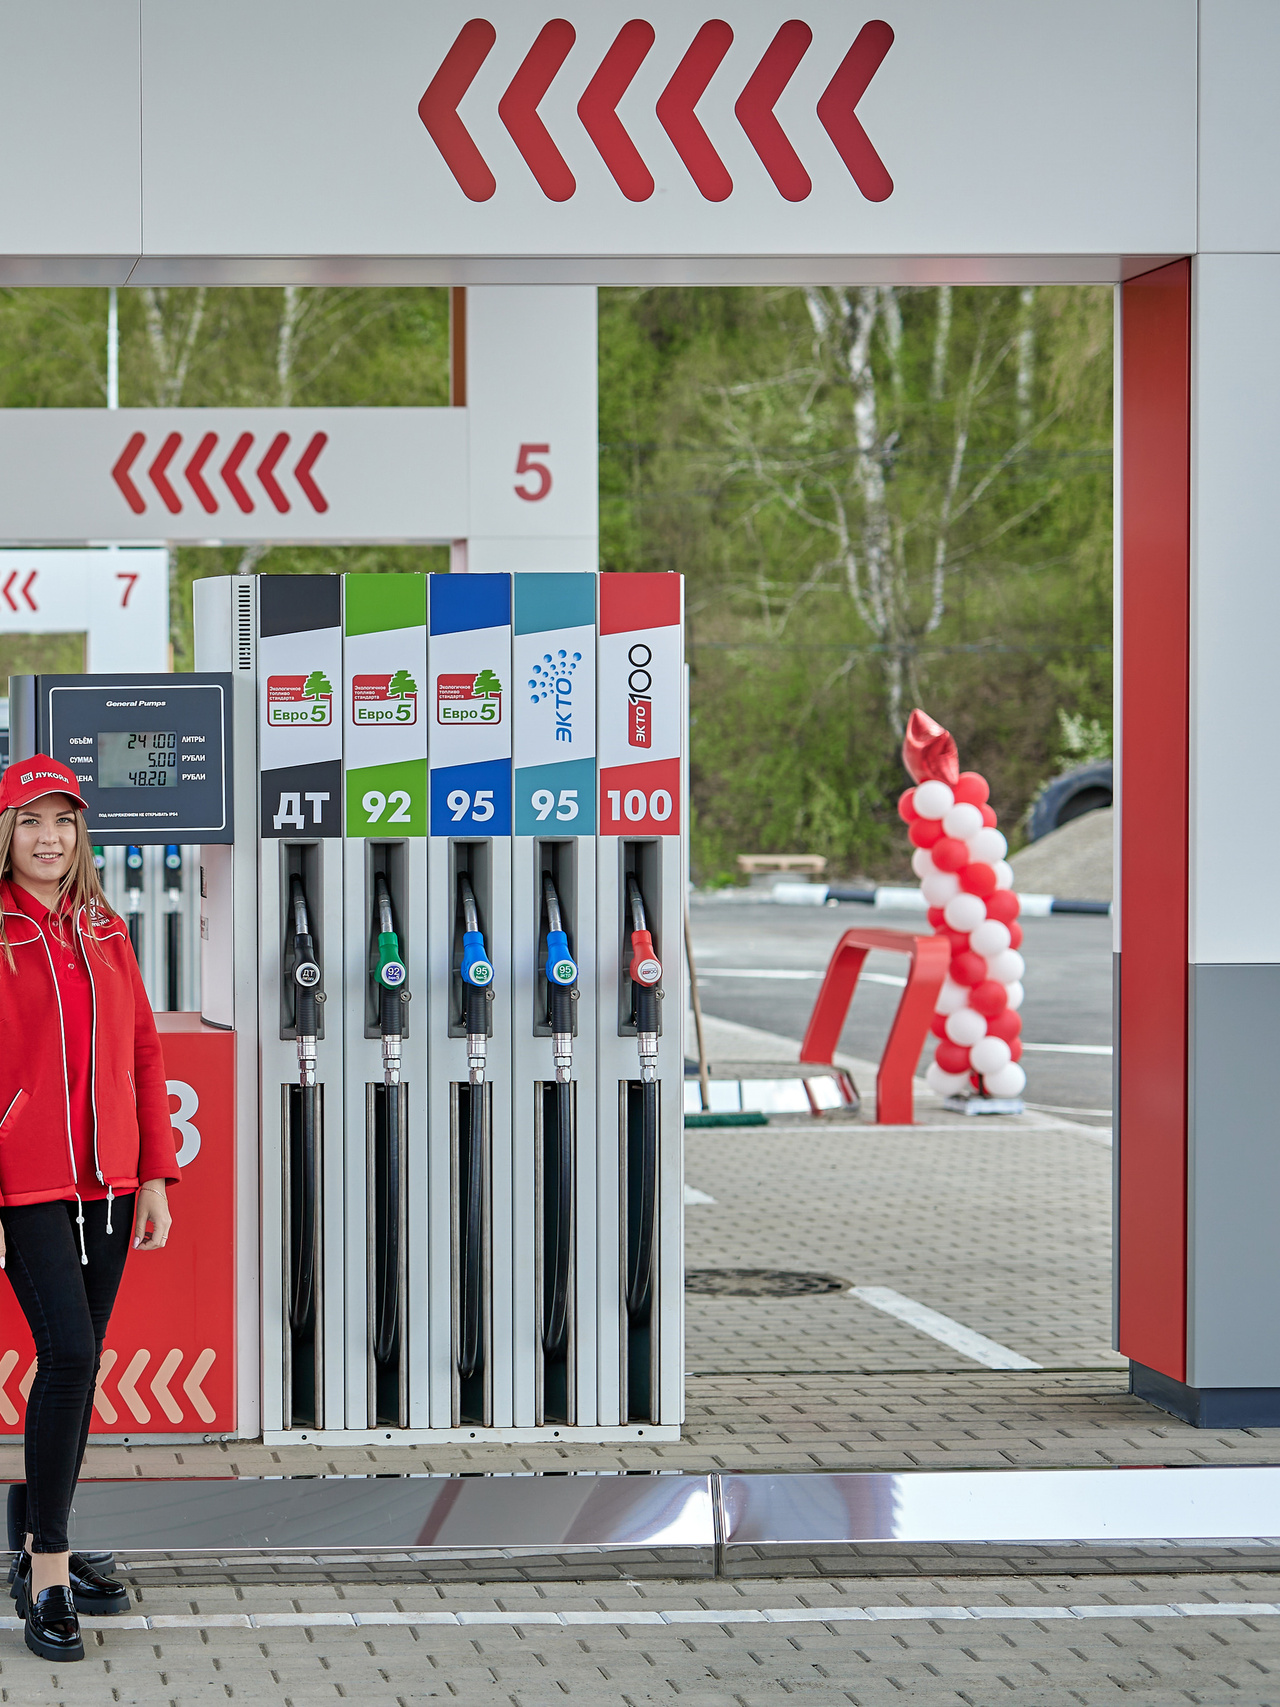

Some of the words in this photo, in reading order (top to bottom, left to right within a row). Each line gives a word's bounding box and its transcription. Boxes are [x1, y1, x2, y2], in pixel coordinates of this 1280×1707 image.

[514, 443, 552, 501] 5
[117, 573, 138, 607] 7
[139, 700, 166, 708] Pumps
[443, 708, 478, 721] Евро
[480, 703, 496, 720] 5
[556, 677, 572, 743] ЭКТО
[273, 709, 308, 722] Евро
[310, 705, 327, 722] 5
[358, 708, 393, 721] Евро
[395, 704, 412, 721] 5
[70, 737, 93, 745] ОБЪЁМ
[148, 752, 176, 767] 5.00
[182, 754, 205, 762] РУБЛИ
[35, 772, 70, 784] ЛУКОЙЛ
[129, 771, 167, 786] 48.20
[182, 773, 206, 781] РУБЛИ
[273, 792, 330, 829] ДТ
[362, 791, 411, 823] 92
[447, 791, 495, 822] 95
[531, 789, 579, 821] 95
[607, 789, 672, 821] 100
[303, 969, 315, 977] ДТ
[388, 967, 400, 976] 92
[475, 967, 487, 975] 95
[559, 965, 571, 974] 95
